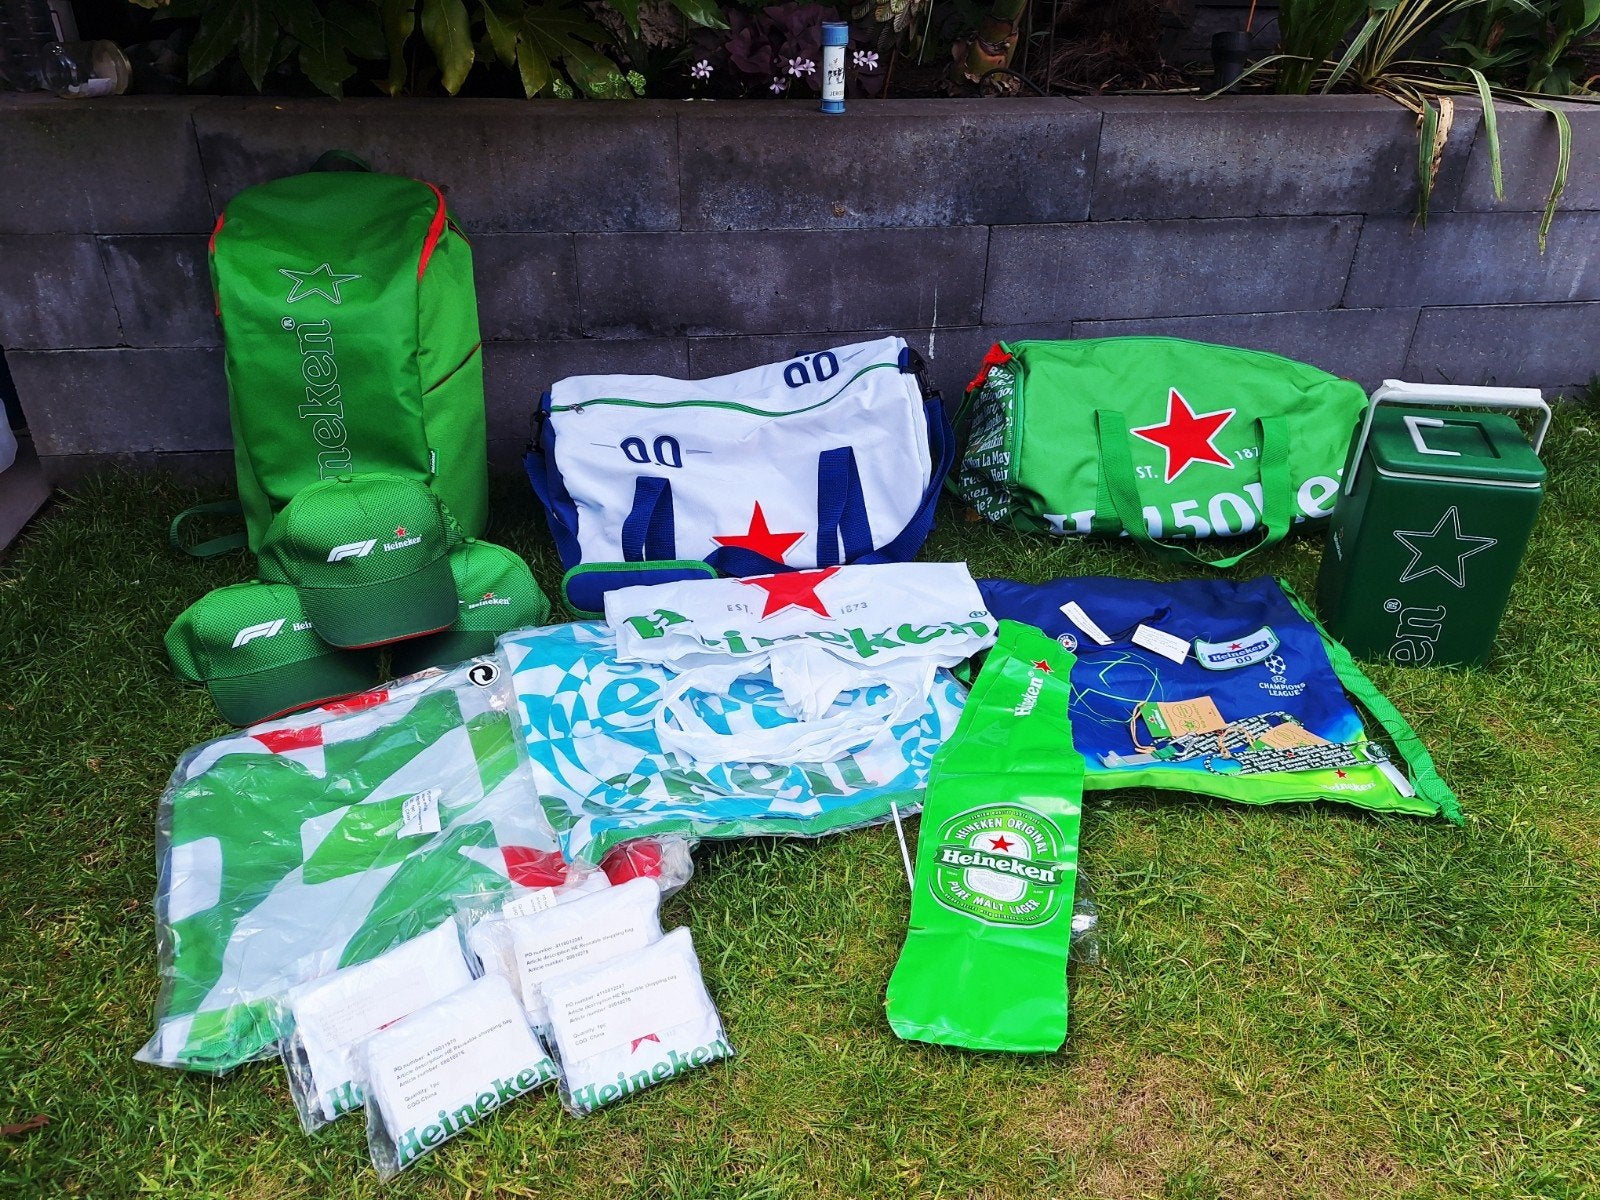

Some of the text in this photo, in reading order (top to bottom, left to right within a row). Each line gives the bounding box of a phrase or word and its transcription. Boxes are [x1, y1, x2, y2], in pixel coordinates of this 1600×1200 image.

[1234, 447, 1260, 460] 187
[1136, 465, 1158, 479] ST.
[383, 534, 422, 552] Heineken
[726, 603, 754, 615] EST.
[840, 601, 868, 614] 1873
[1211, 641, 1267, 661] Heineken
[955, 817, 1003, 840] HEINEKEN
[1007, 818, 1049, 854] ORIGINAL
[941, 849, 1056, 882] Heineken
[948, 880, 971, 901] PURE
[972, 896, 1004, 911] MALT
[1009, 898, 1041, 915] LAGER
[572, 1039, 729, 1112] Heineken
[398, 1055, 559, 1166] Heineken
